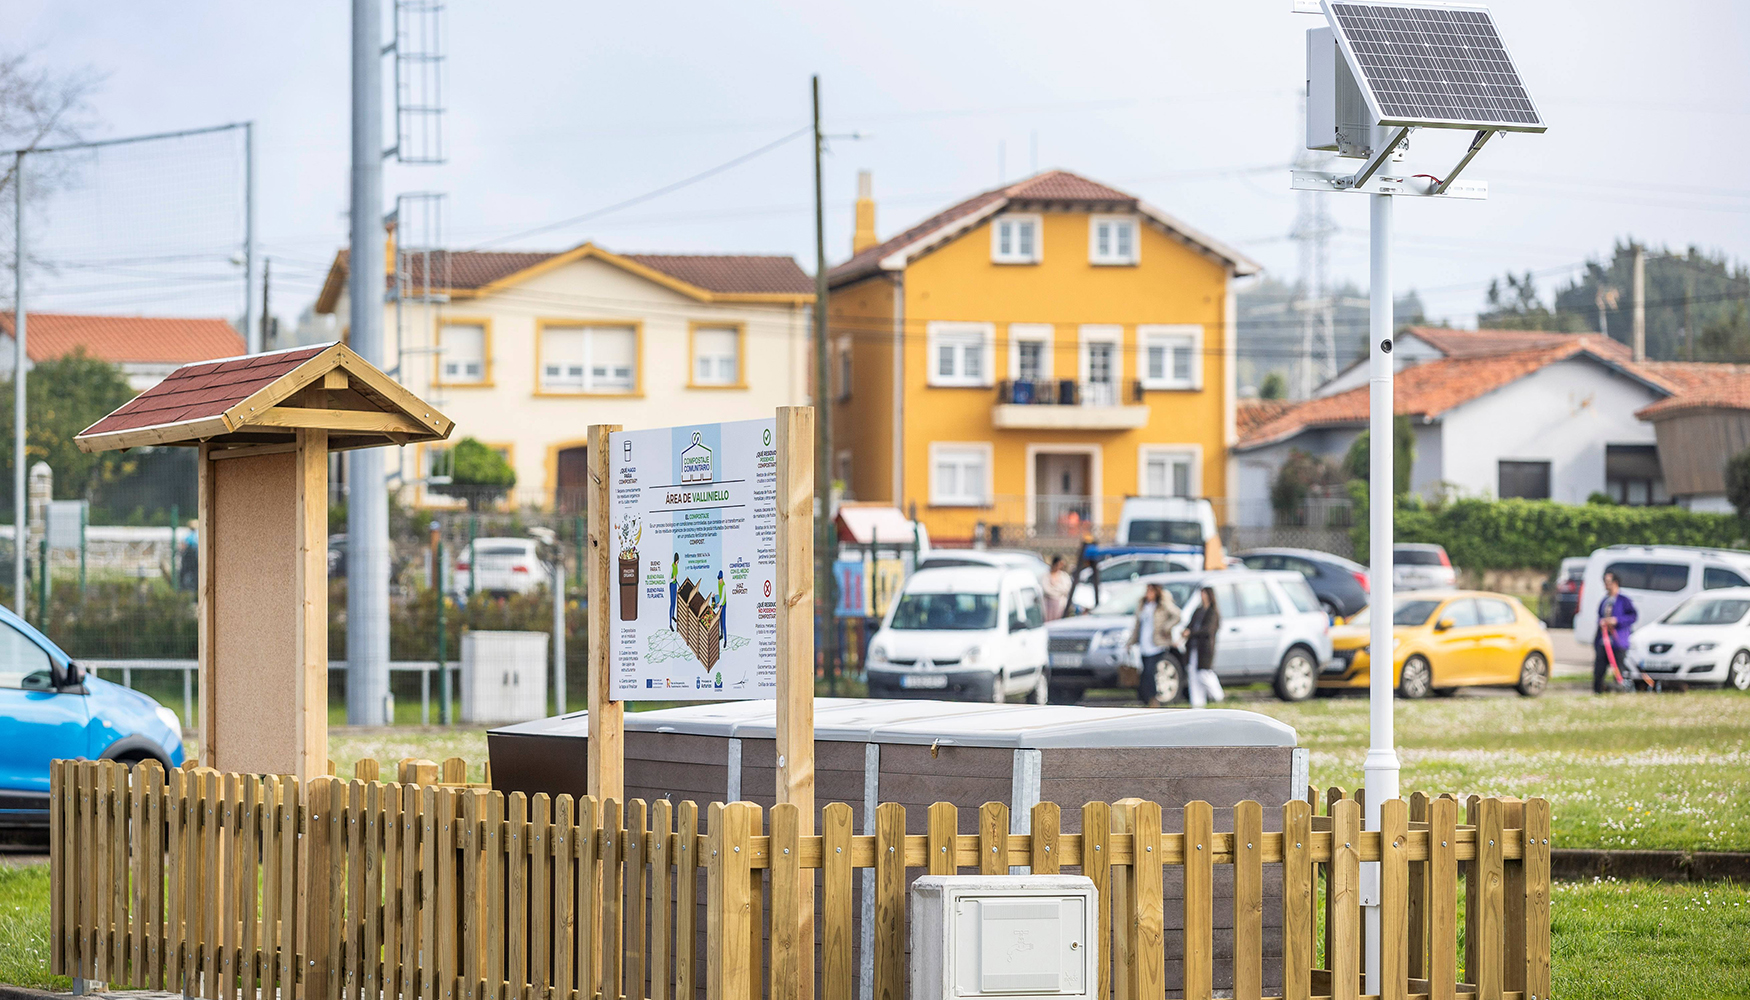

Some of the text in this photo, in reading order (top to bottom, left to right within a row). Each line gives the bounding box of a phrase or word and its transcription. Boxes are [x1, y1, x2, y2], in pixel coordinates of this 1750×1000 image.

[684, 456, 709, 465] COMPOSTAJE
[684, 464, 710, 472] COMUNITARIO
[666, 490, 729, 504] ÁREA DE VALLINIELLO
